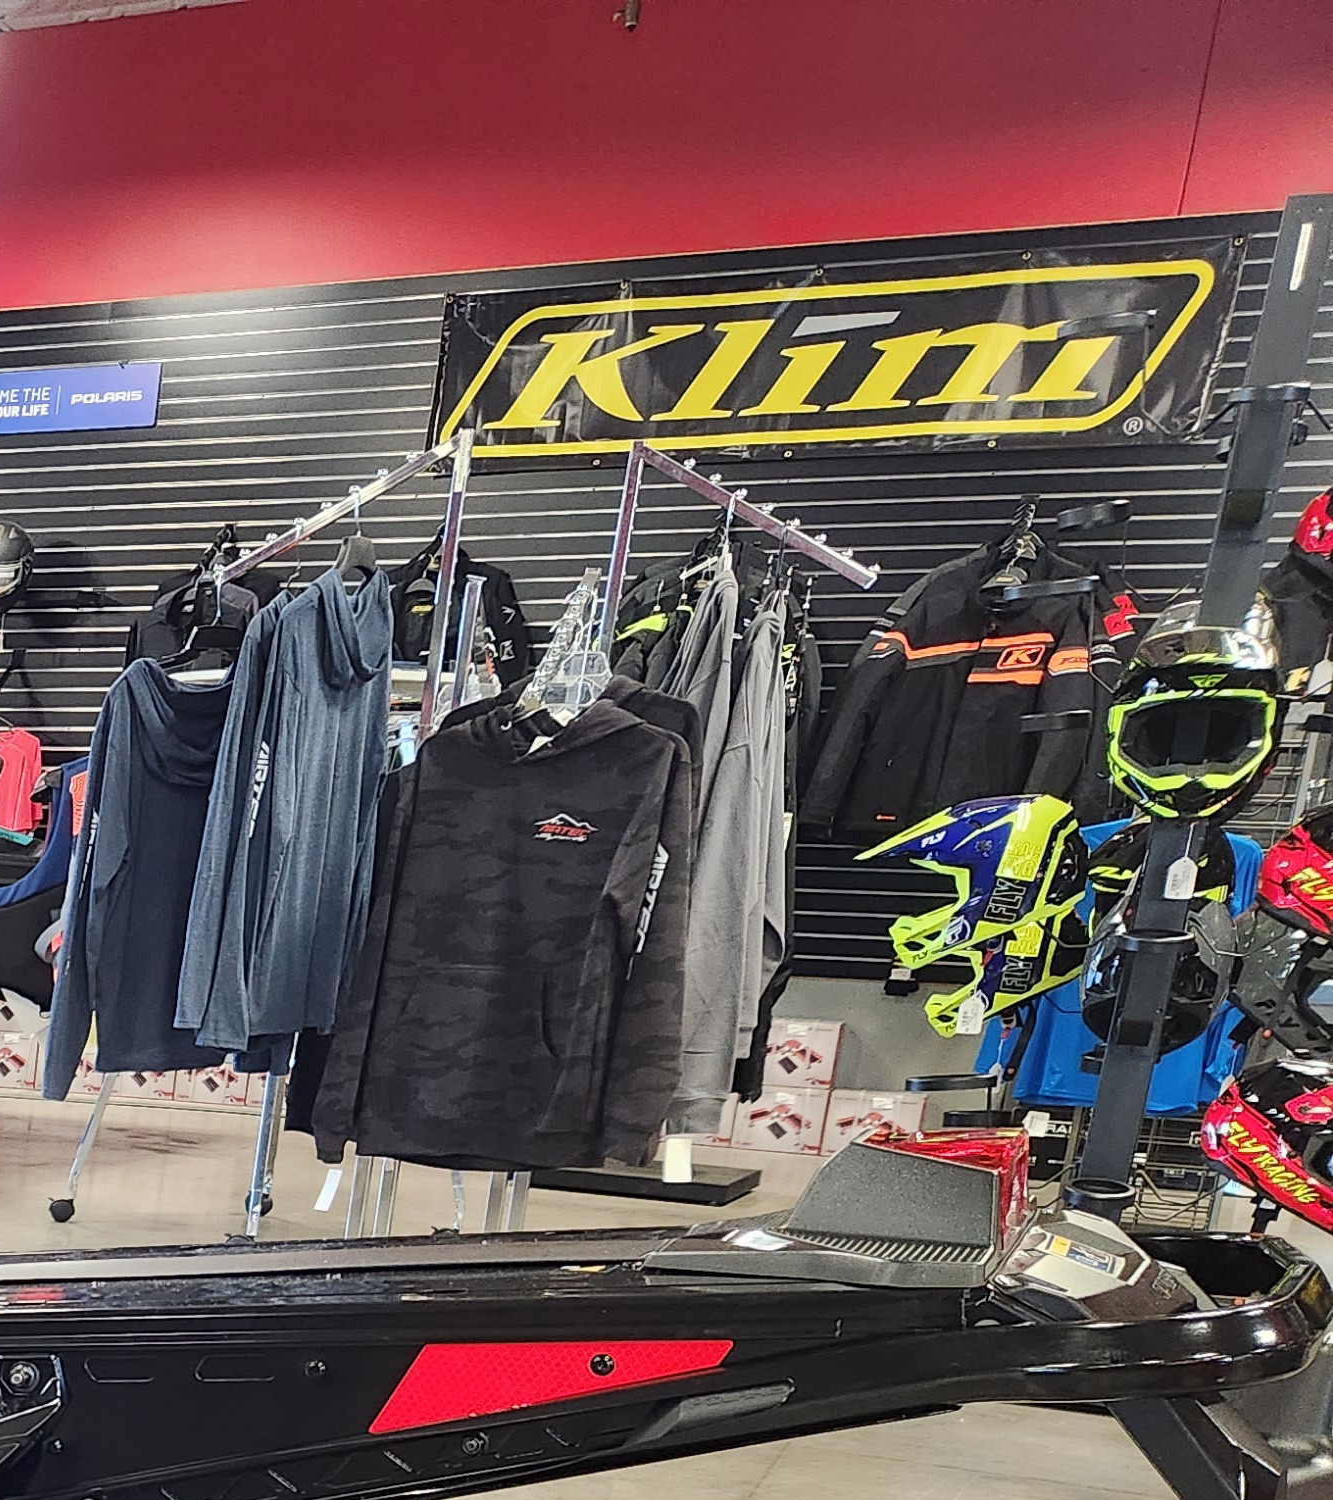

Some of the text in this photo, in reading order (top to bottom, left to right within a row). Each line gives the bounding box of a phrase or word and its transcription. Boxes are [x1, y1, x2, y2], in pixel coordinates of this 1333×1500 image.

[23, 386, 51, 402] THE
[71, 390, 143, 405] POLARIS
[22, 403, 49, 417] LIFE
[921, 830, 947, 849] FLY
[635, 841, 670, 954] AIRTEC
[984, 878, 1028, 923] FLY
[912, 949, 929, 964] FLY
[1000, 954, 1034, 993] FLY
[1253, 1152, 1321, 1203] RACING
